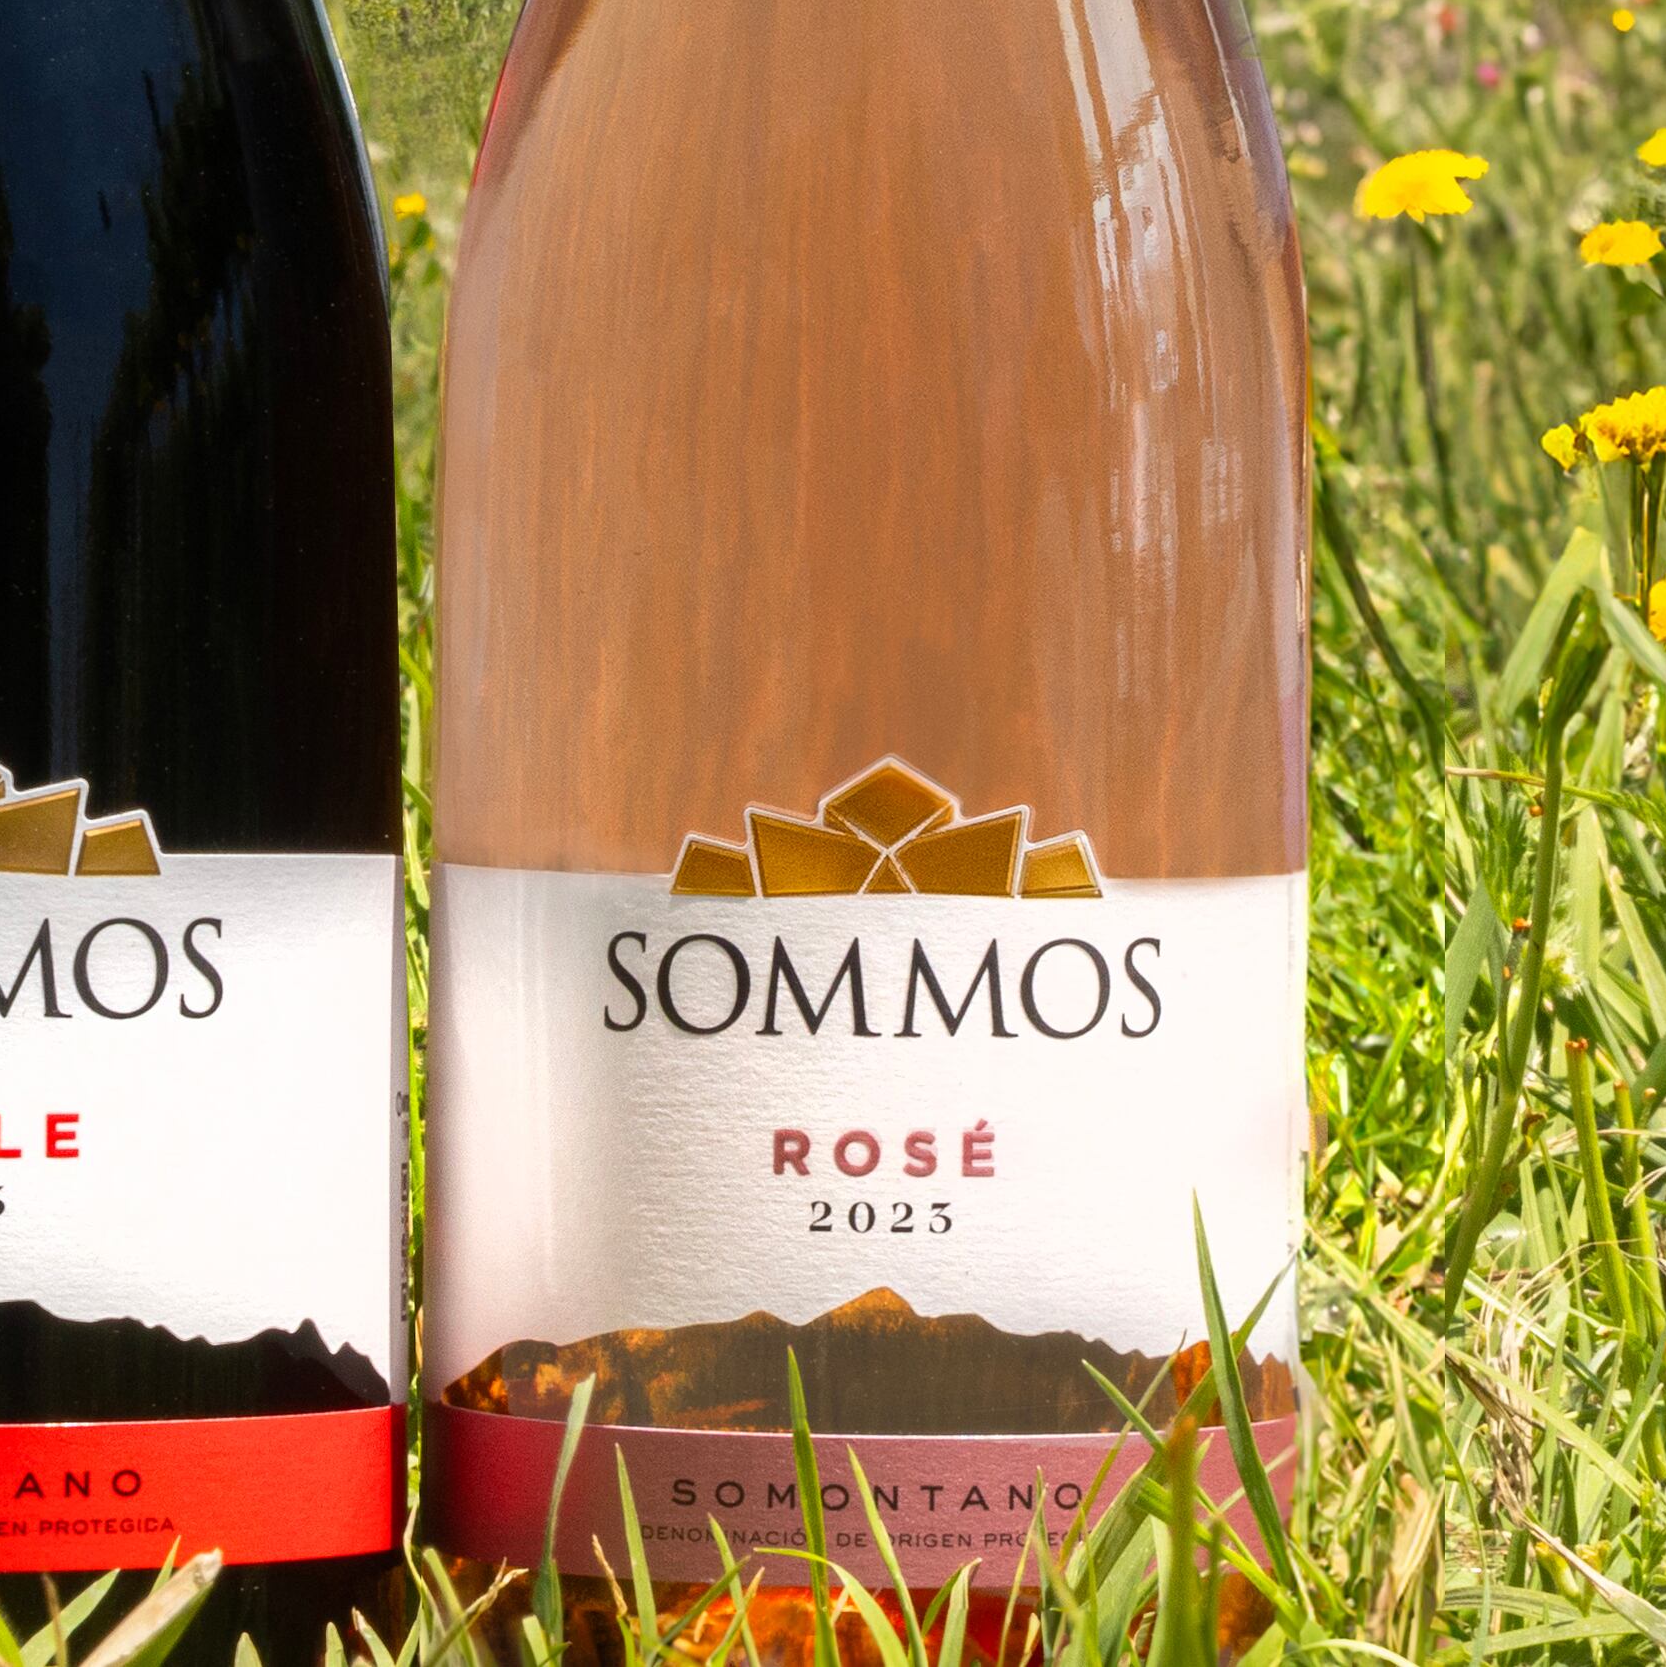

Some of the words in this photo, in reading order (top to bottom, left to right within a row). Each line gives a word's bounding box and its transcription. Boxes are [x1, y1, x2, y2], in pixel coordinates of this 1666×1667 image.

[603, 931, 1162, 1039] SOMMOS
[772, 1119, 998, 1179] ROSÉ
[808, 1200, 954, 1233] 2023
[671, 1479, 1082, 1511] SOMONTANO
[836, 1532, 867, 1548] DE
